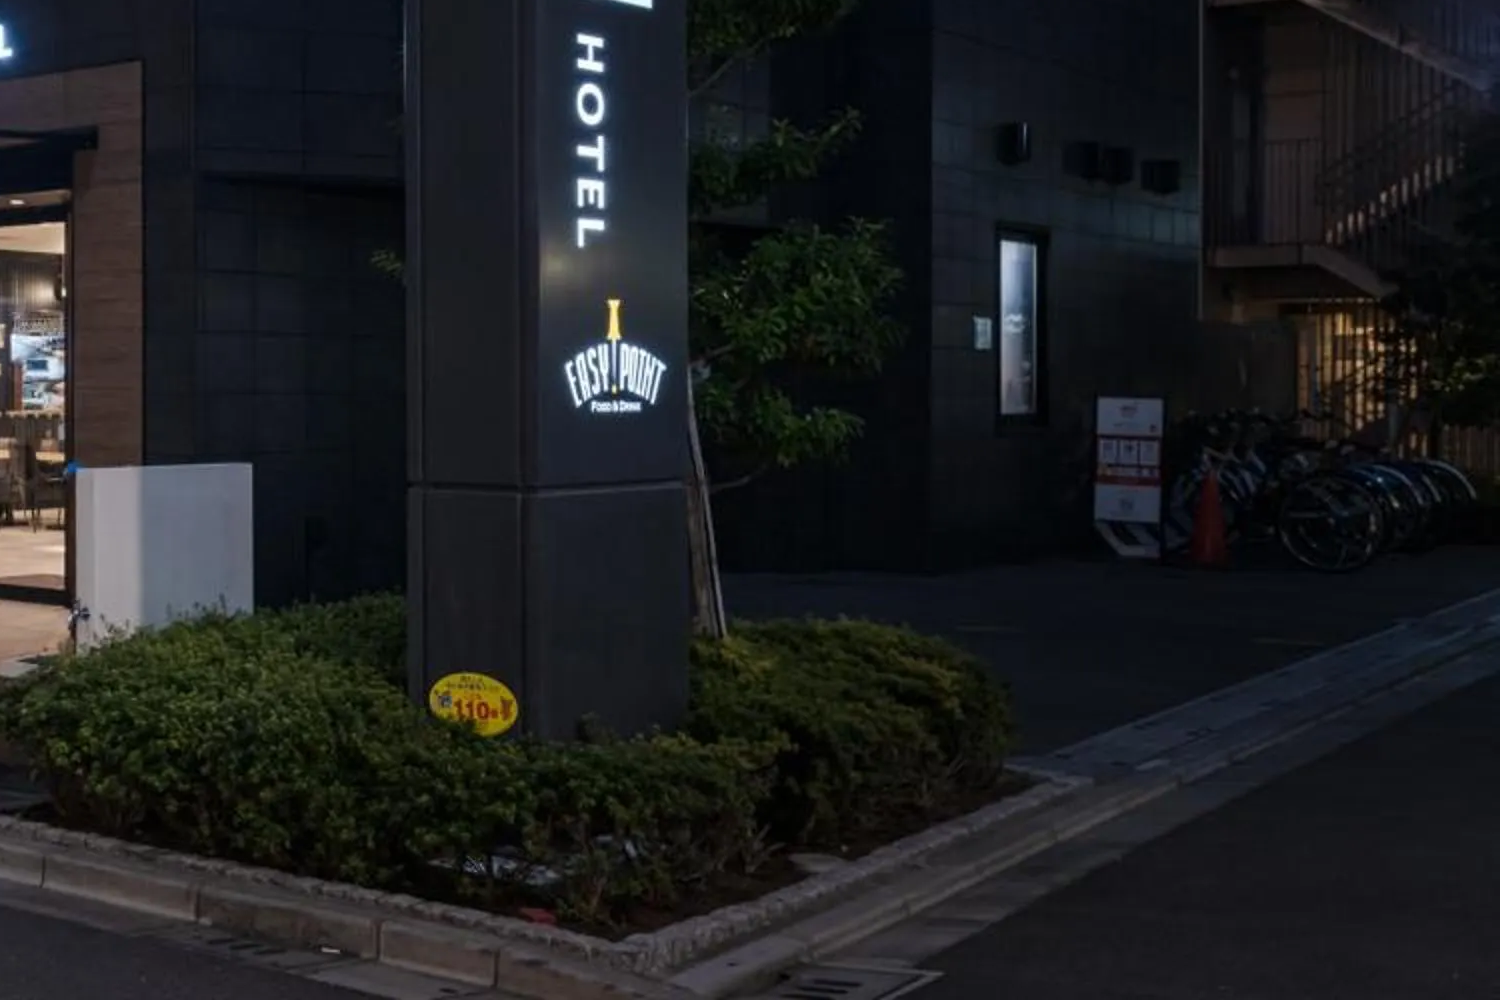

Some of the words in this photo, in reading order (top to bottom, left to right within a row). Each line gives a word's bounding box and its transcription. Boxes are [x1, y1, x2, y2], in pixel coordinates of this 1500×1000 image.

[576, 33, 605, 248] HOTEL
[564, 343, 609, 408] EASY
[619, 343, 667, 406] POINT
